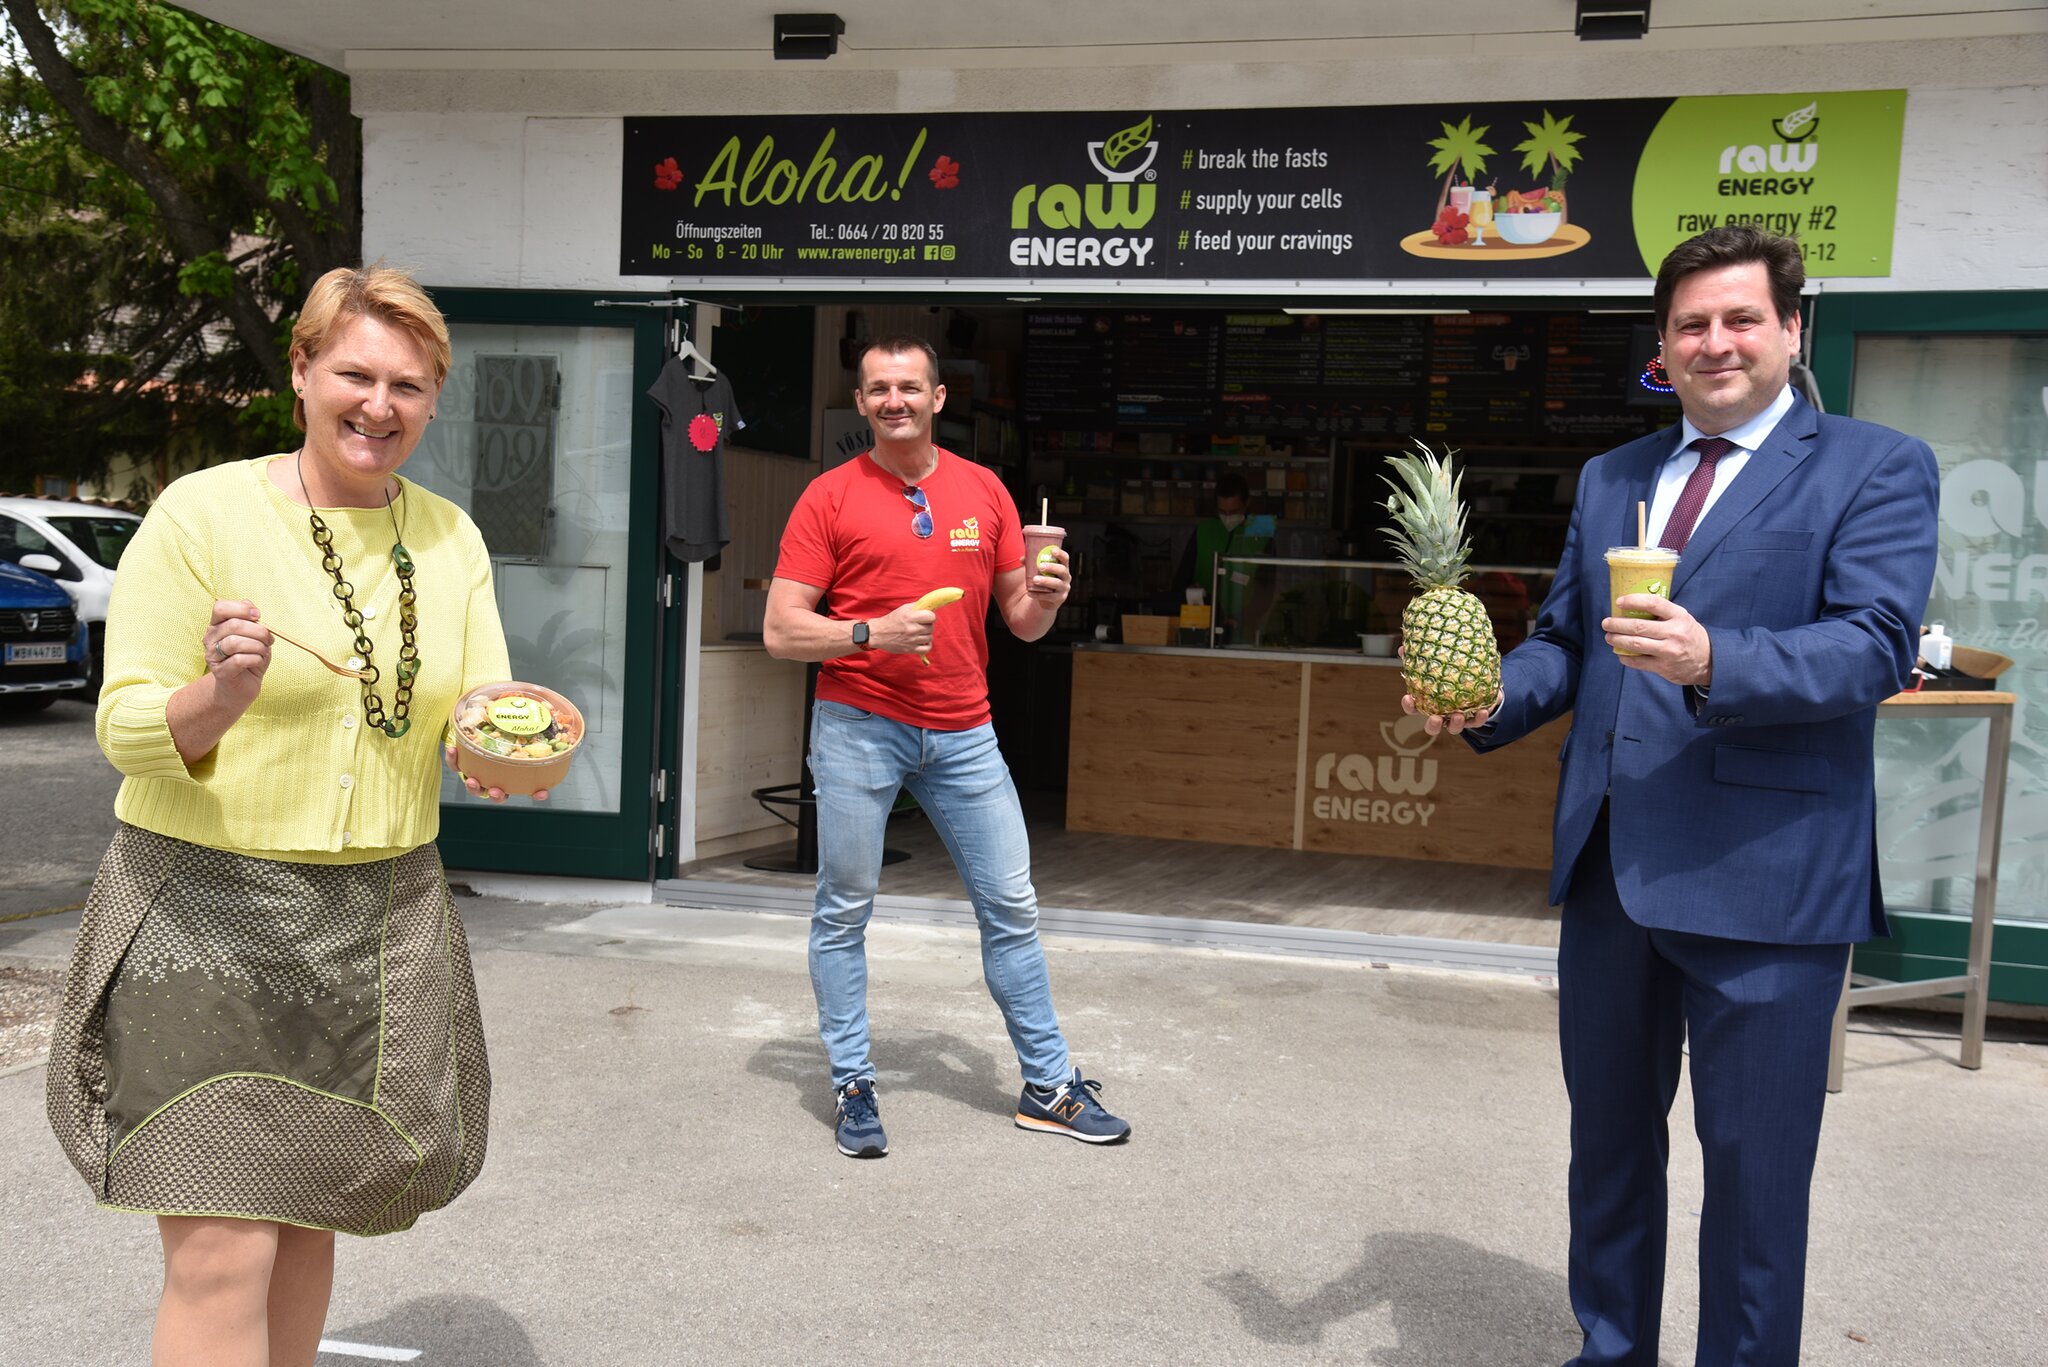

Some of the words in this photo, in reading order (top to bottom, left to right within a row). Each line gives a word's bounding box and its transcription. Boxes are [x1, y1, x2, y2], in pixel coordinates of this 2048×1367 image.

[694, 127, 927, 207] Aloha!
[1199, 149, 1246, 169] break
[1252, 149, 1279, 168] the
[1285, 148, 1327, 168] fasts
[1719, 143, 1818, 174] raw
[1718, 177, 1814, 196] ENERGY
[1011, 184, 1157, 229] raw
[1196, 190, 1251, 214] supply
[1257, 194, 1295, 214] your
[1300, 189, 1342, 209] cells
[676, 220, 762, 242] Öffnungszeiten
[1677, 213, 1717, 232] raw
[1808, 205, 1837, 230] #2
[810, 224, 834, 240] Tel.:
[838, 224, 868, 240] 0664
[882, 224, 897, 240] 20
[901, 223, 924, 239] 820
[928, 223, 944, 239] 55
[1194, 230, 1231, 250] feed
[1237, 234, 1275, 254] your
[1280, 230, 1352, 254] cravings
[652, 244, 670, 260] Mo
[687, 244, 703, 260] So
[716, 244, 724, 260] 8
[741, 244, 757, 260] 20
[762, 244, 784, 260] Uhr
[798, 245, 915, 263] www.rawenergy.at
[1009, 237, 1154, 267] ENERGY
[836, 429, 873, 455] VÖSL
[950, 528, 979, 539] raw
[950, 539, 980, 547] ENERGY
[1929, 552, 2048, 601] NER
[1315, 753, 1438, 796] raw
[1313, 795, 1435, 827] ENERGY
